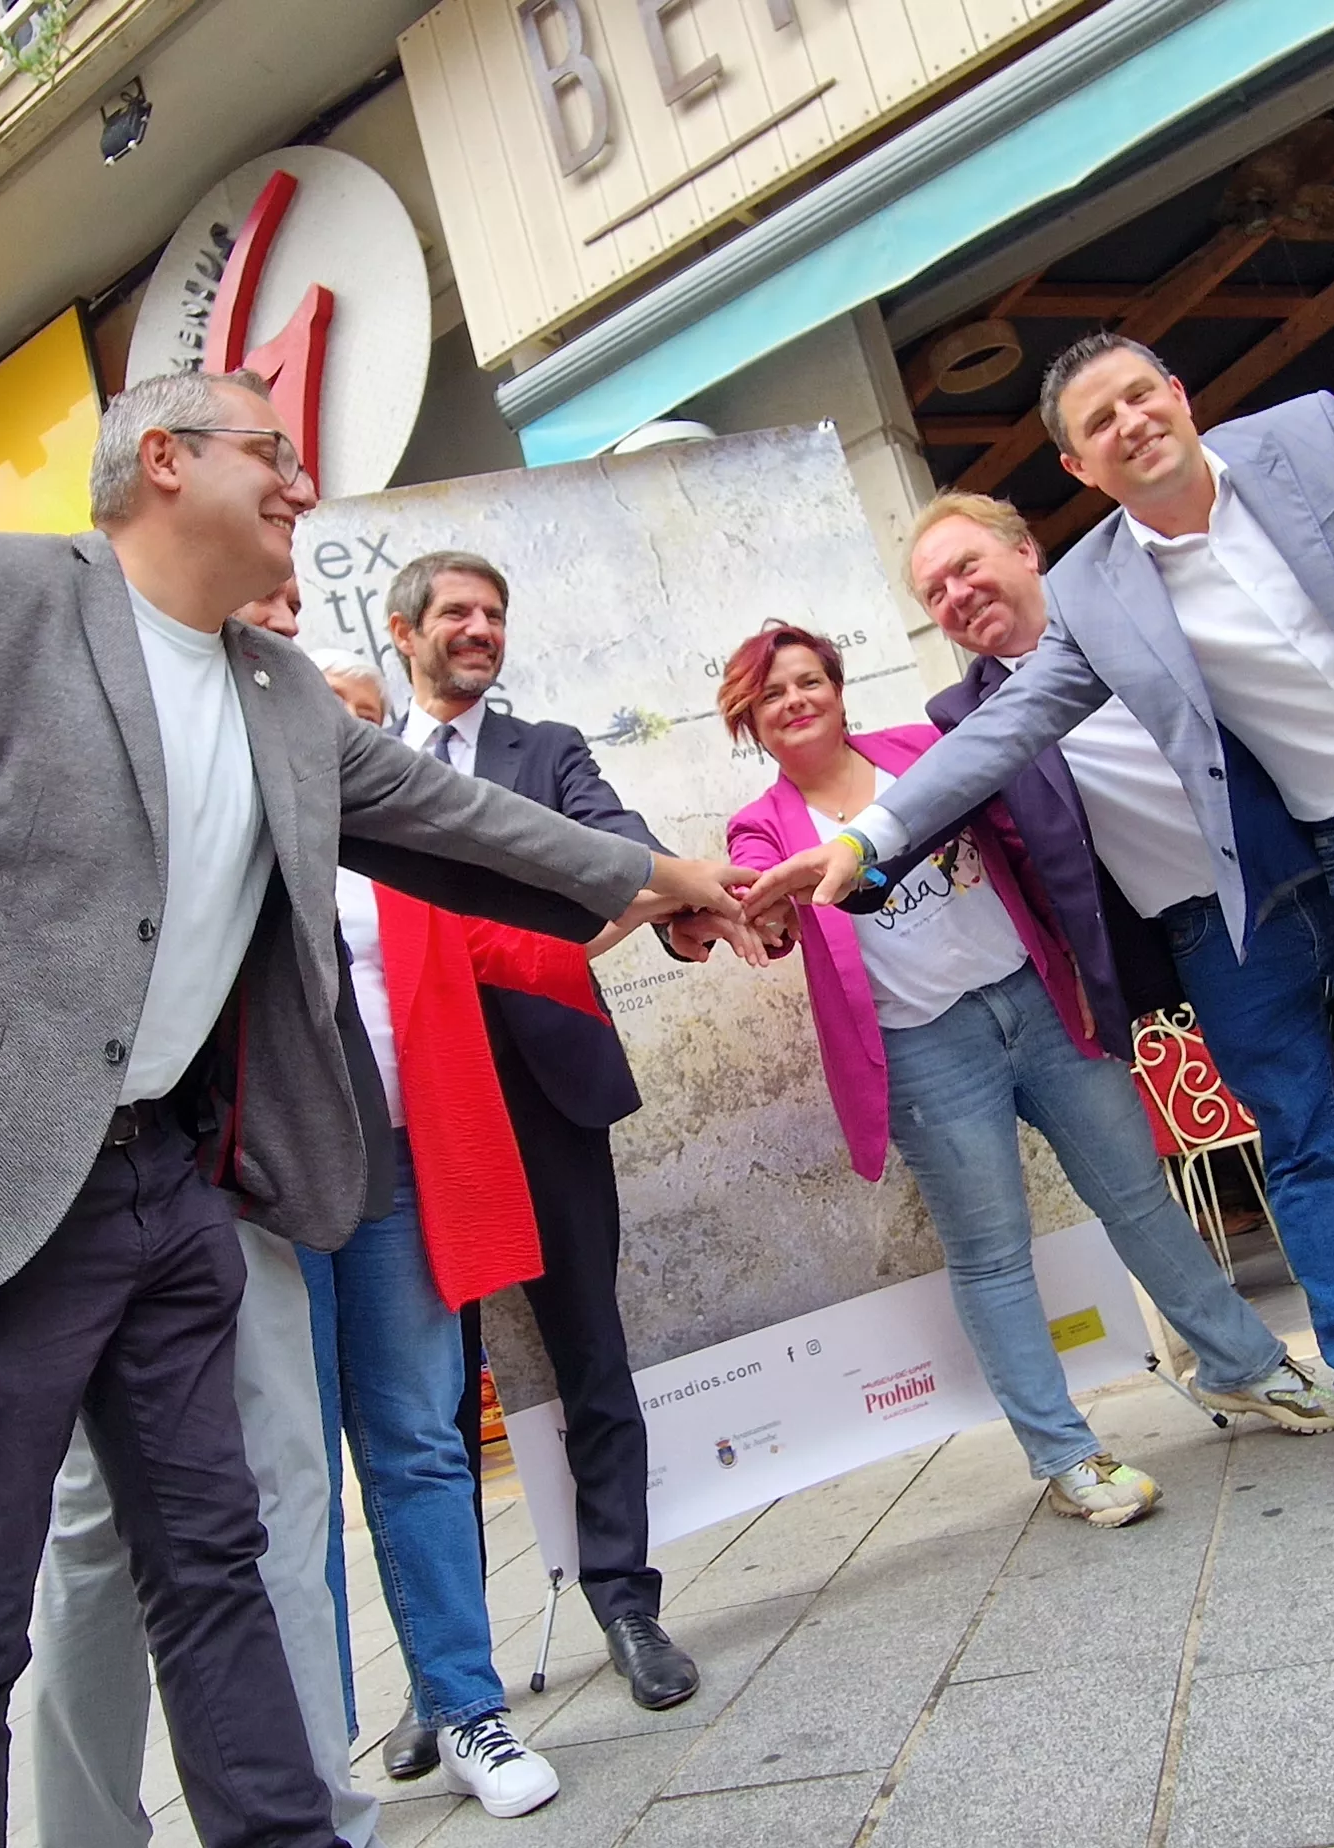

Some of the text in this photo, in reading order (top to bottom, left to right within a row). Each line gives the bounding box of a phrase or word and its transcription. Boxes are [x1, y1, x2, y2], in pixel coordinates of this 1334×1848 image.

[314, 533, 399, 580] ex
[618, 993, 653, 1014] 2024
[642, 1361, 763, 1412] rarradios.com
[864, 1373, 936, 1414] Prohibit
